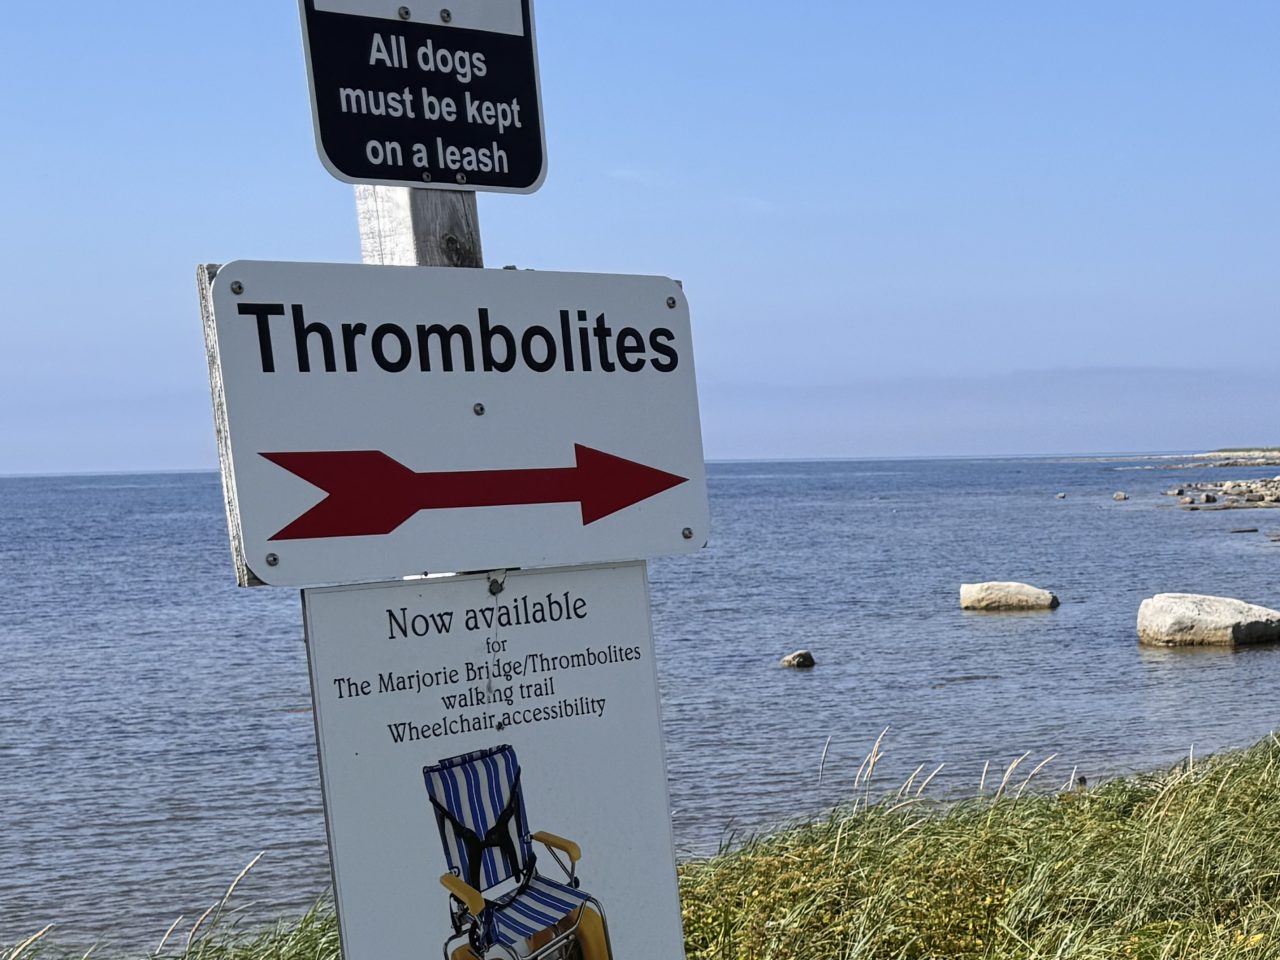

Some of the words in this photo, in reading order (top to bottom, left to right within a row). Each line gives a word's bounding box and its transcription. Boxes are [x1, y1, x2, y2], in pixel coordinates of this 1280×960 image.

[369, 33, 407, 69] All
[417, 39, 487, 84] dogs
[339, 86, 414, 119] must
[422, 88, 457, 122] be
[466, 91, 522, 133] kept
[366, 140, 403, 167] on
[413, 144, 428, 168] a
[437, 137, 508, 174] leash
[237, 303, 679, 374] Thrombolites
[386, 607, 453, 640] Now
[465, 591, 587, 631] available
[485, 638, 507, 654] for
[334, 677, 371, 699] The
[378, 666, 459, 695] Marjorie
[465, 644, 641, 682] Bridge/Thrombolites
[519, 677, 555, 700] trail
[387, 711, 496, 743] Wheelchair
[501, 697, 606, 727] accessibility
